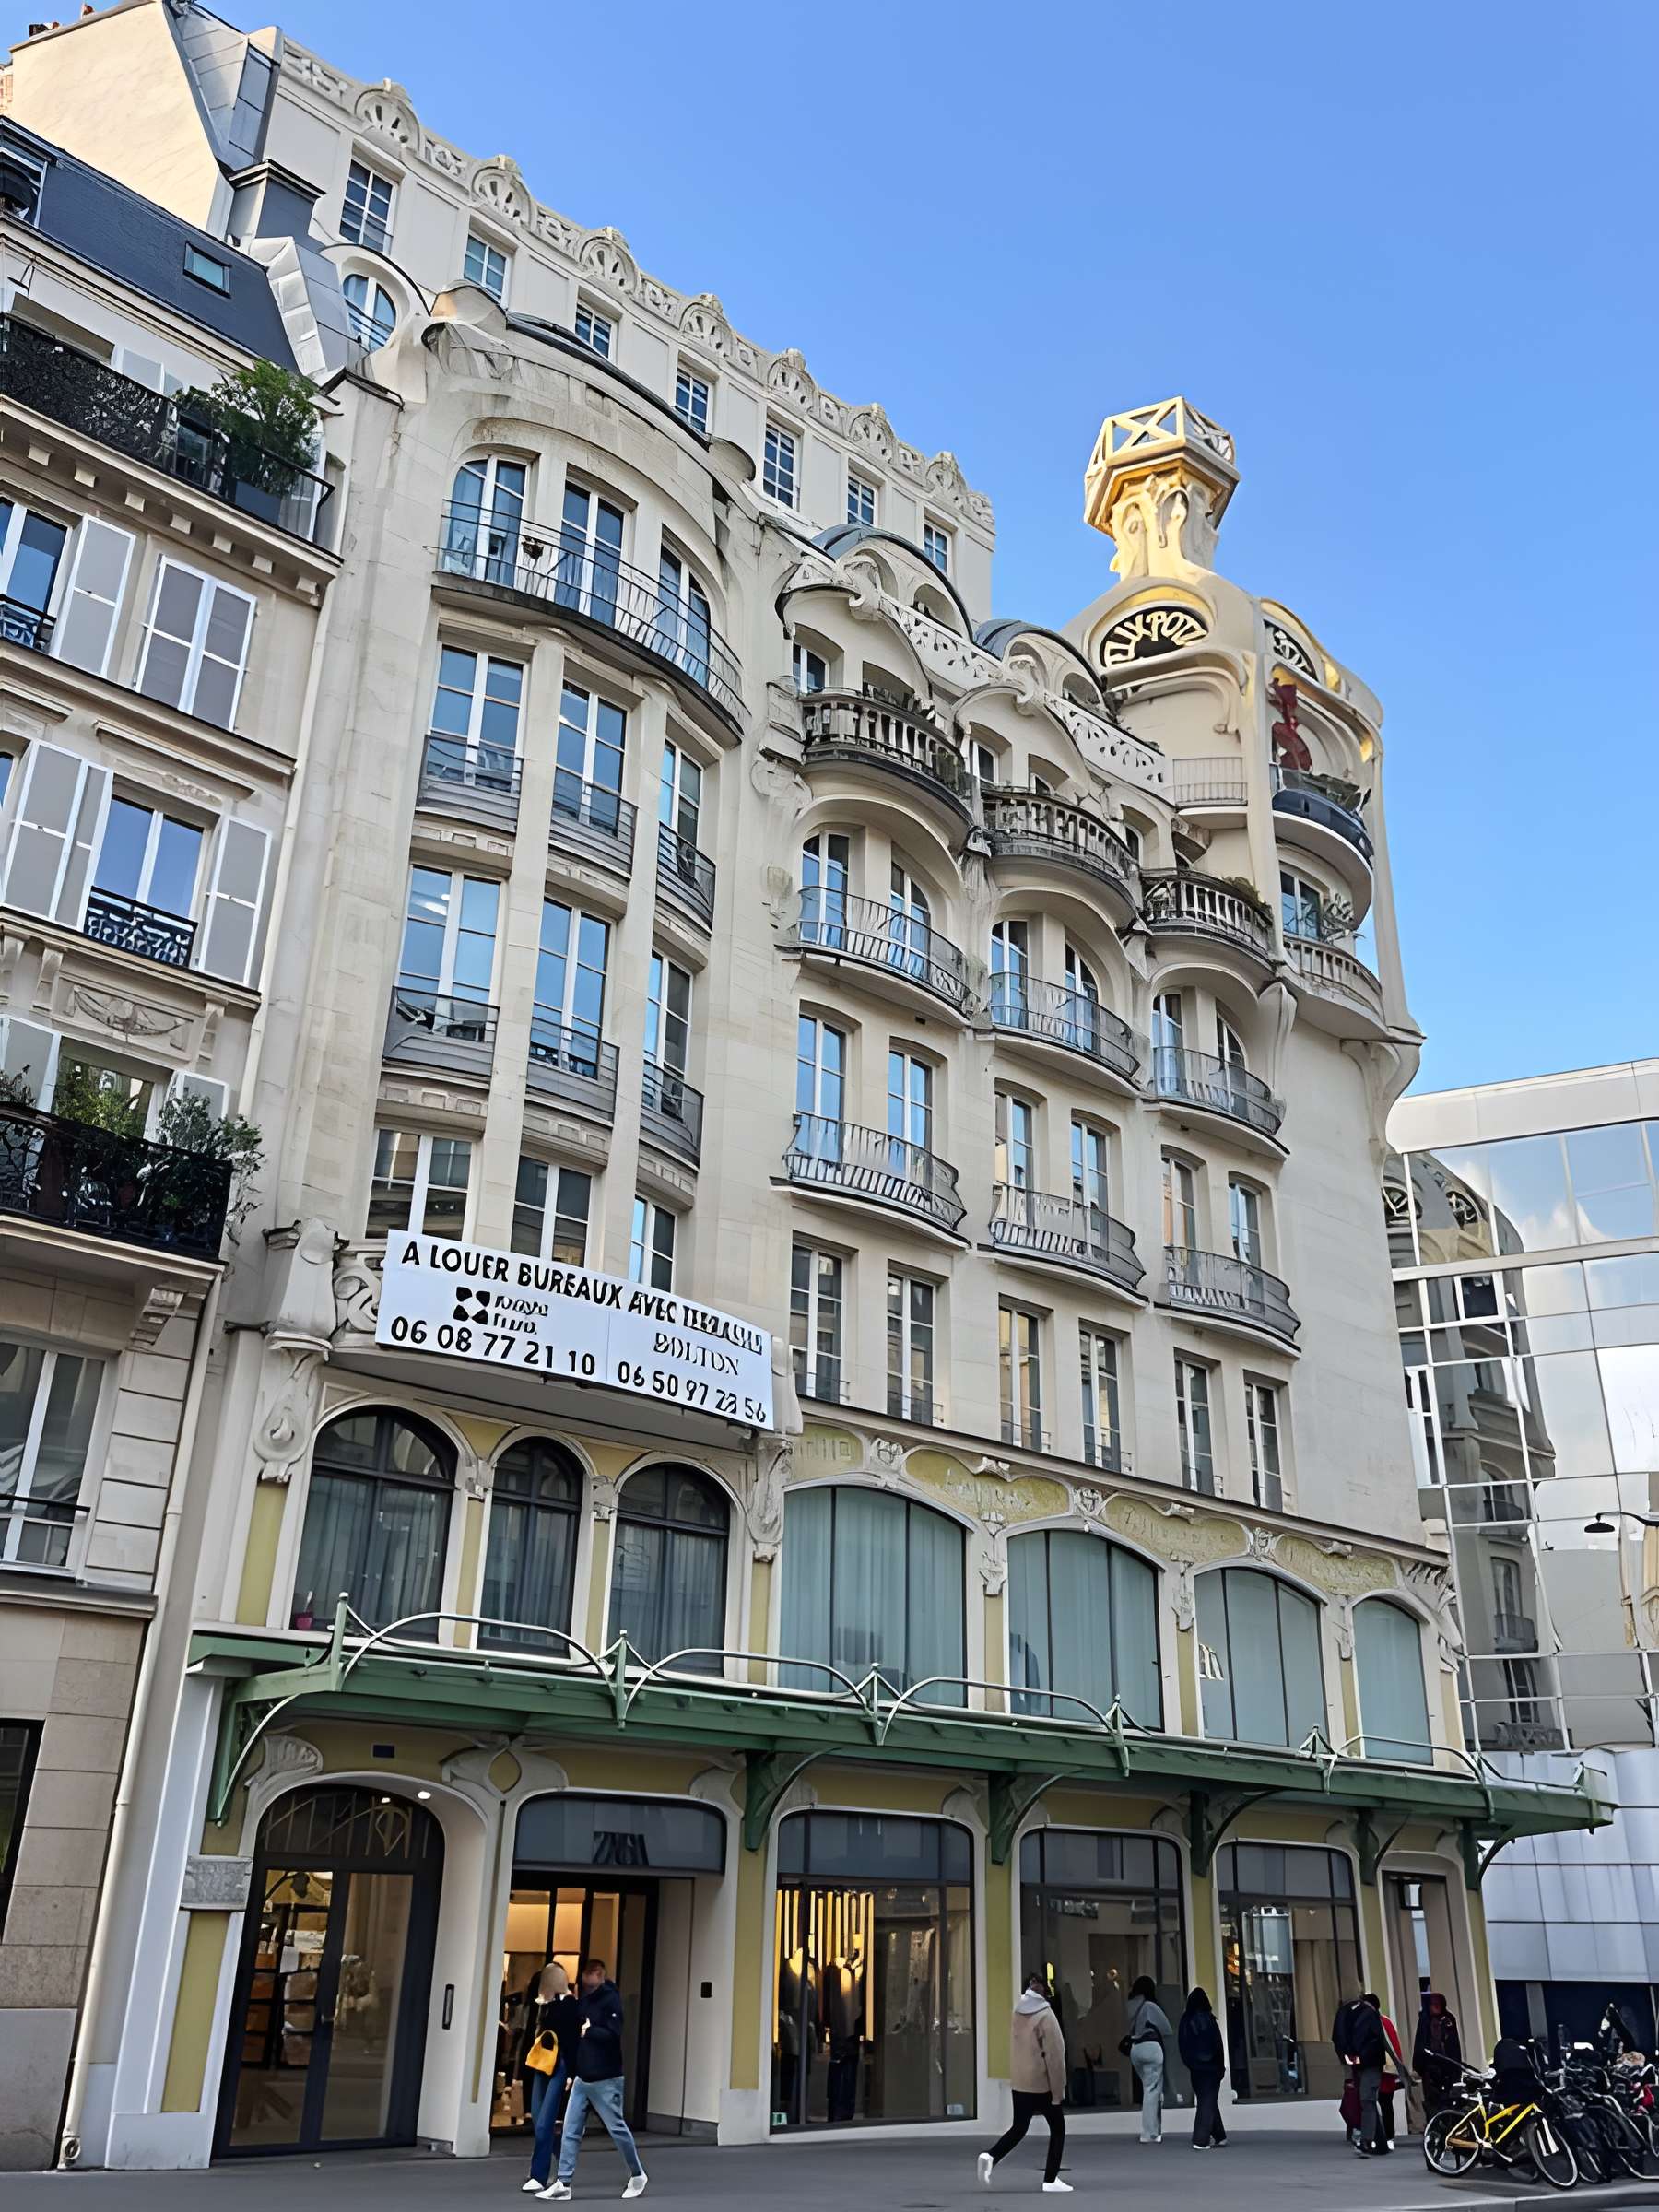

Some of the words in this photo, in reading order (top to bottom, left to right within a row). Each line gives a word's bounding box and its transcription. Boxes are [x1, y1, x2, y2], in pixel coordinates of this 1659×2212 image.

[401, 1241, 420, 1265] A
[430, 1245, 508, 1282] LOUER
[518, 1263, 623, 1309] BUREAUX
[629, 1291, 677, 1323] AVEC
[391, 1316, 427, 1344] 06
[438, 1325, 472, 1352] 08
[483, 1333, 515, 1359] 77
[524, 1341, 553, 1368] 21
[569, 1351, 595, 1375] 10
[618, 1361, 645, 1387] 06
[653, 1371, 678, 1397] 50
[686, 1380, 709, 1405] 97
